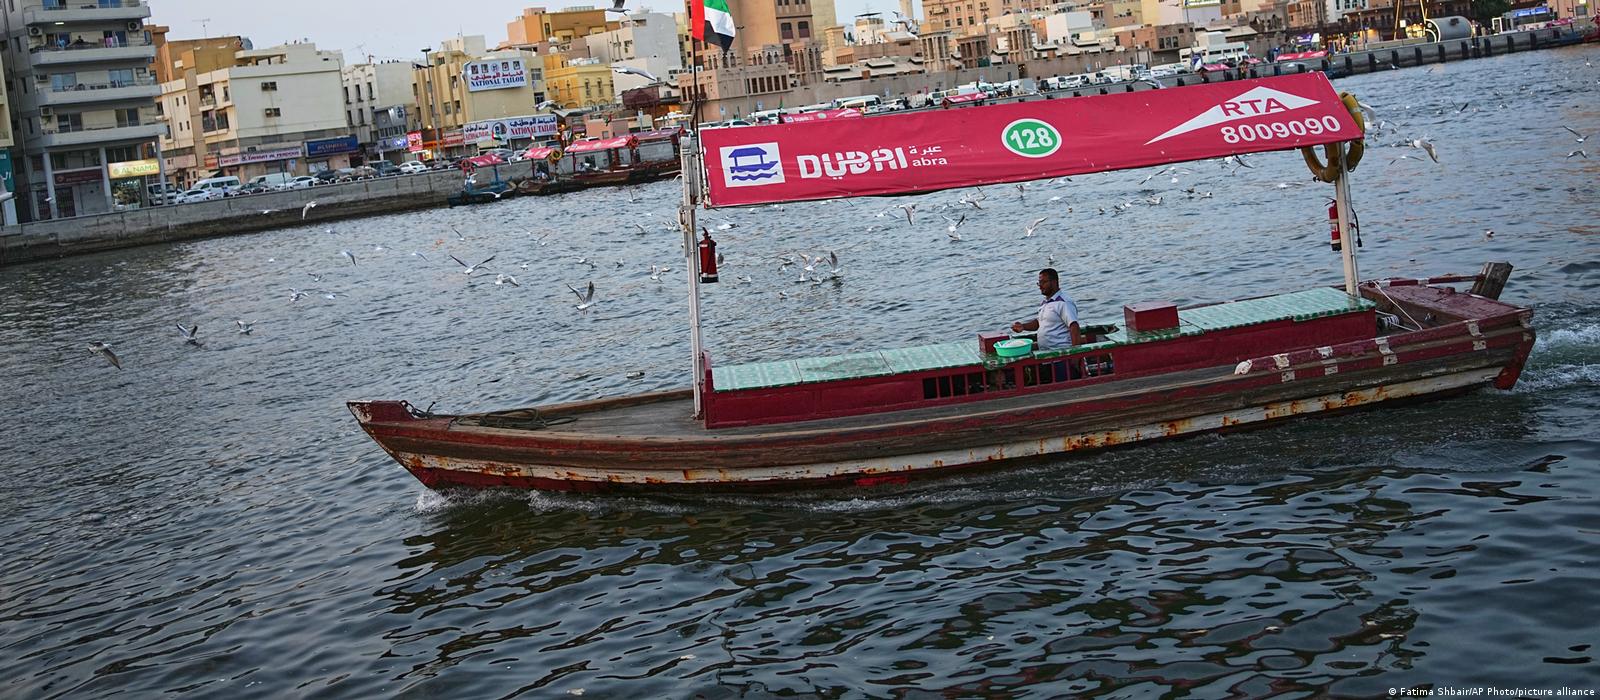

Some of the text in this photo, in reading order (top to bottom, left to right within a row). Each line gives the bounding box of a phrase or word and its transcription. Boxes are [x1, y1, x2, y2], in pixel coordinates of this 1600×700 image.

[471, 78, 501, 87] NATIONAL
[502, 76, 525, 84] TAILOR
[1220, 98, 1287, 117] RTA
[510, 123, 557, 136] NATIONAL TAILOR
[1009, 127, 1053, 150] 128
[1221, 115, 1341, 144] 8009090
[796, 147, 909, 180] DUBAI
[912, 156, 948, 168] abra
